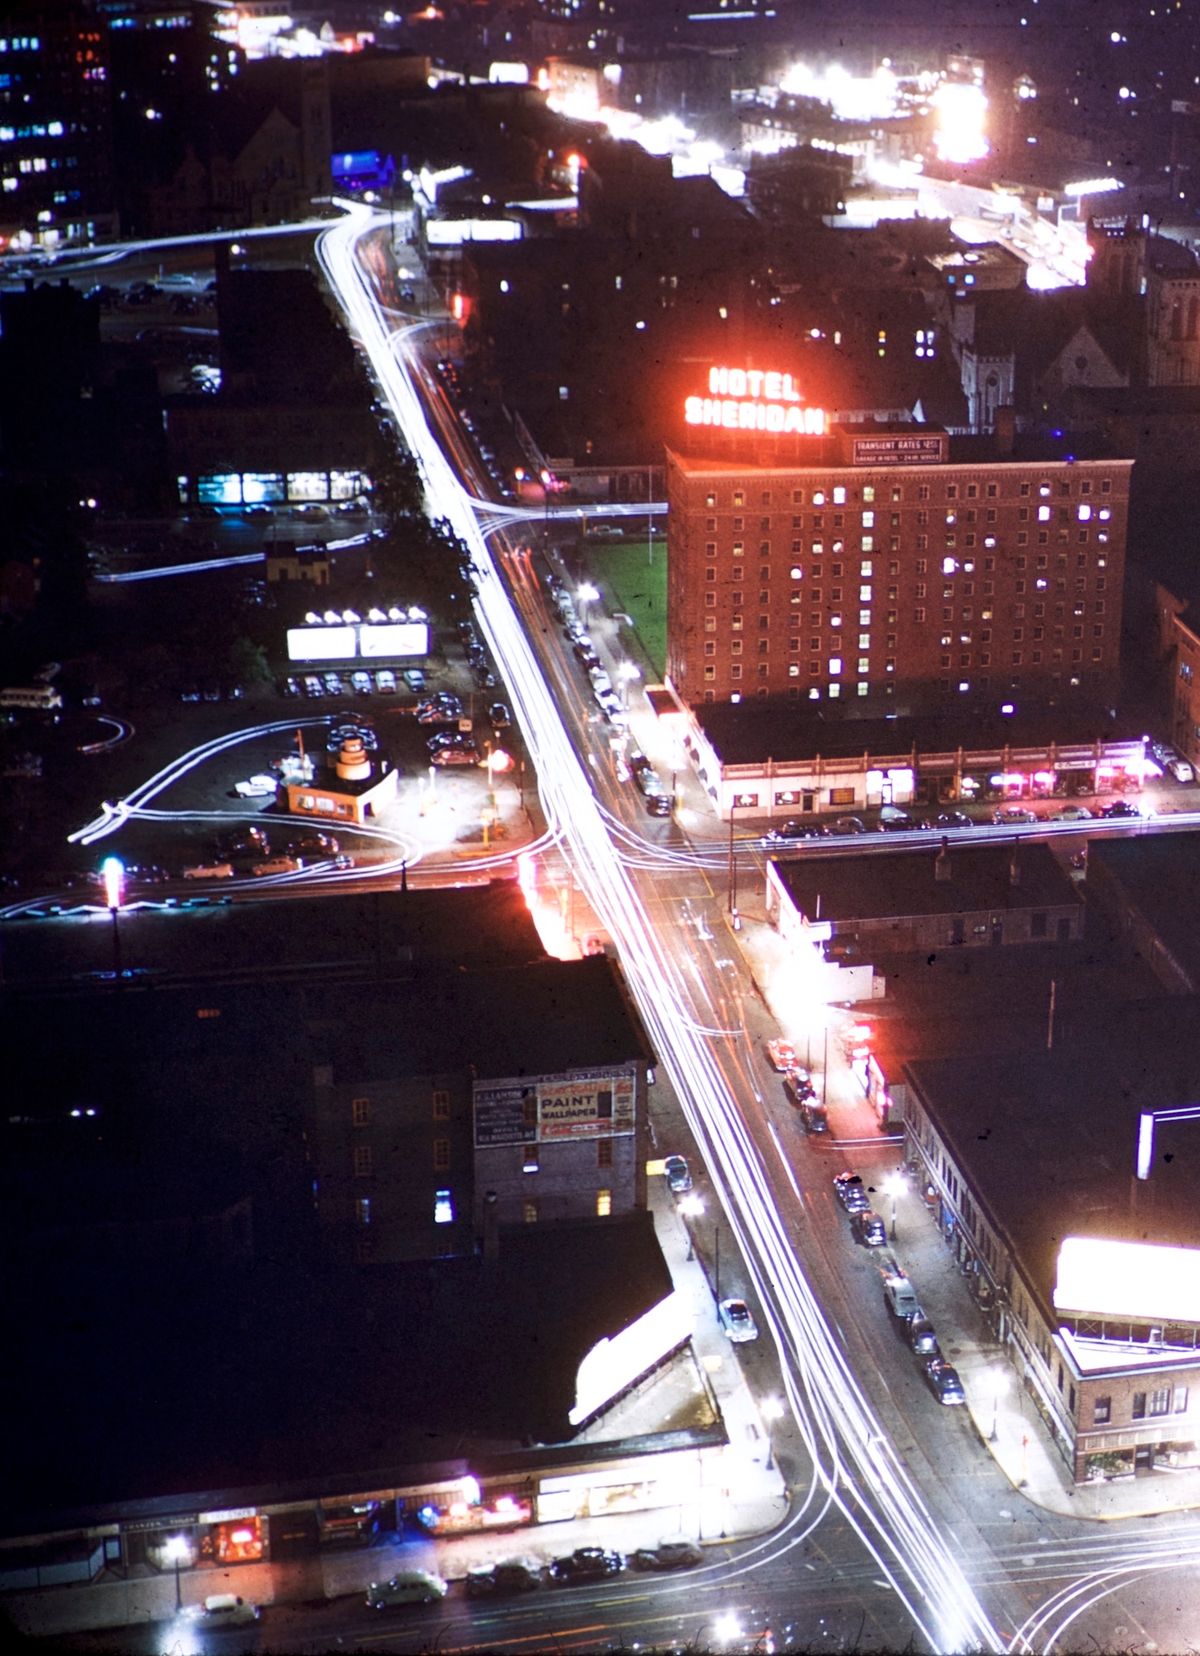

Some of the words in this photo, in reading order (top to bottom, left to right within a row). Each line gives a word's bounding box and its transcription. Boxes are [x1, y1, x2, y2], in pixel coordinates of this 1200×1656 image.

[709, 366, 802, 401] HOTEL
[684, 396, 826, 436] SHERIDAN
[857, 441, 895, 450] TRANSIENT
[541, 1095, 594, 1109] PAINT
[541, 1108, 596, 1119] WALLPAPER
